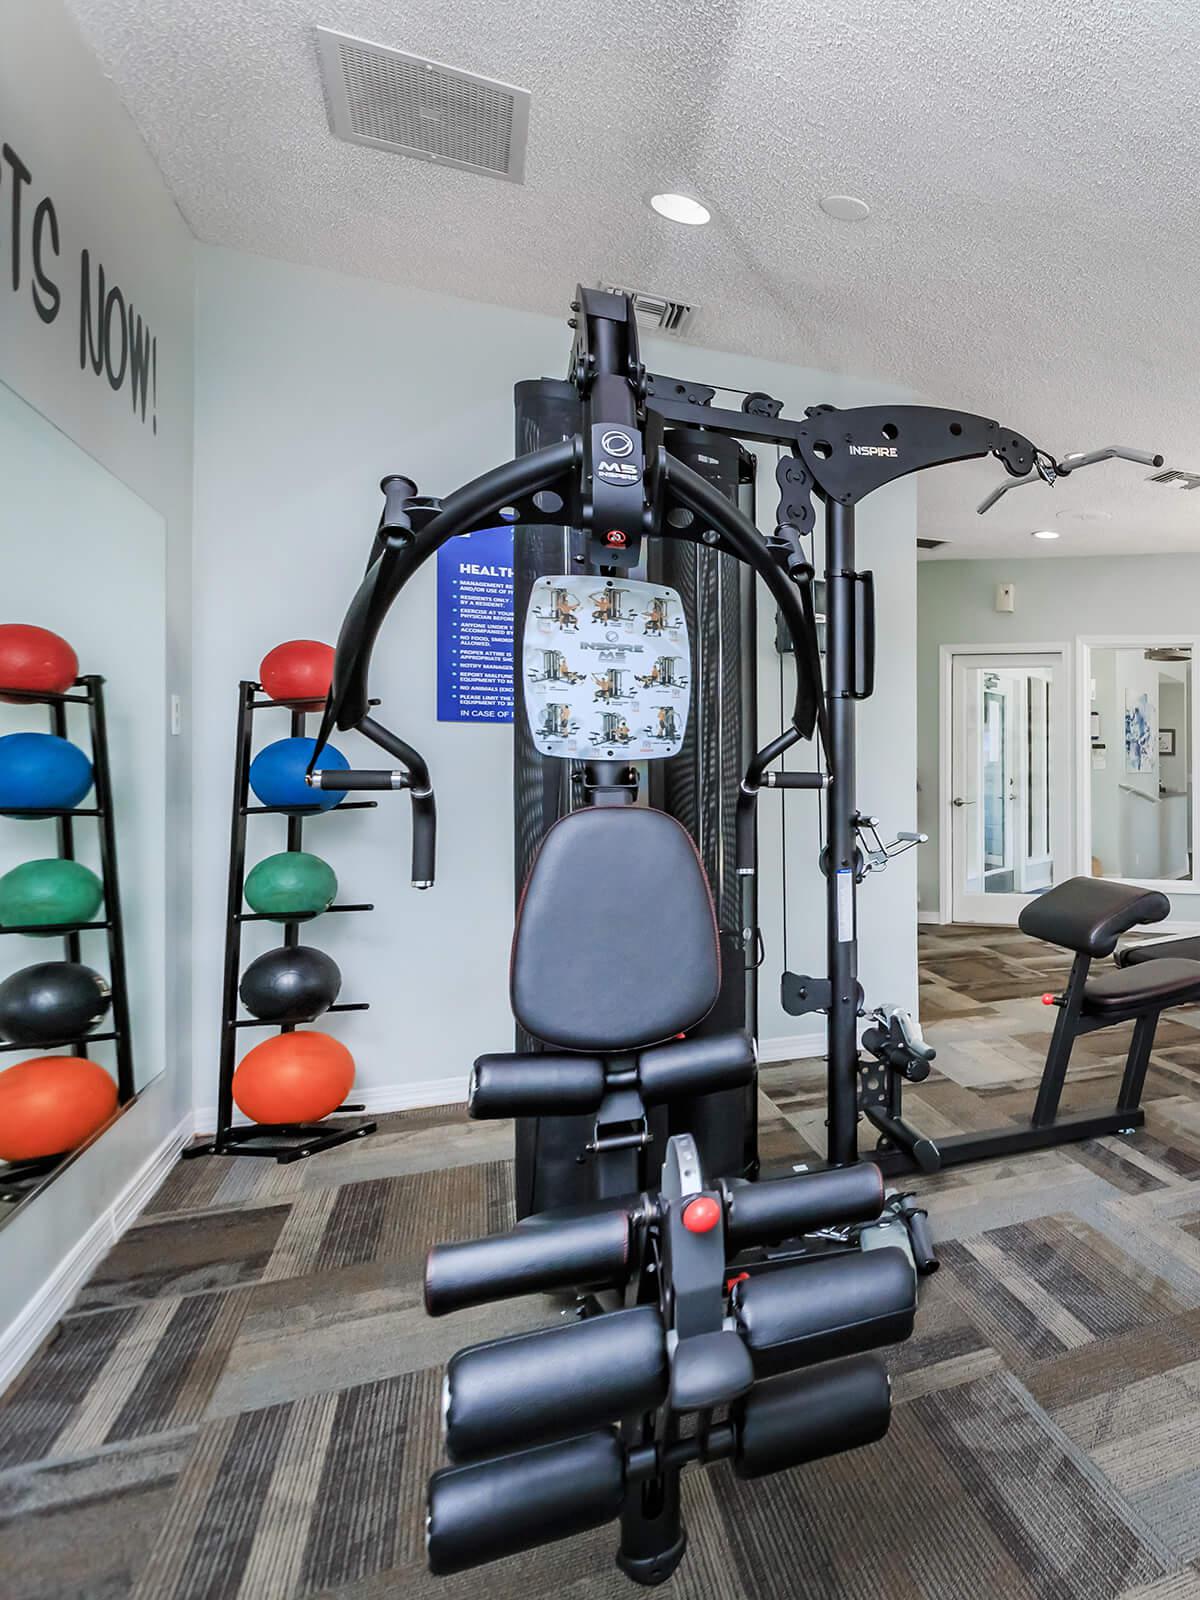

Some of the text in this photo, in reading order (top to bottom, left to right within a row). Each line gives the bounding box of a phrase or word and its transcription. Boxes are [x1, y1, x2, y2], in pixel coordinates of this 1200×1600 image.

[0, 142, 157, 436] TS NOW!
[849, 445, 899, 458] INSPIRE
[598, 461, 638, 475] M5
[598, 471, 639, 481] INSPIRE
[580, 641, 644, 653] INSPIRE
[471, 710, 496, 718] CASE
